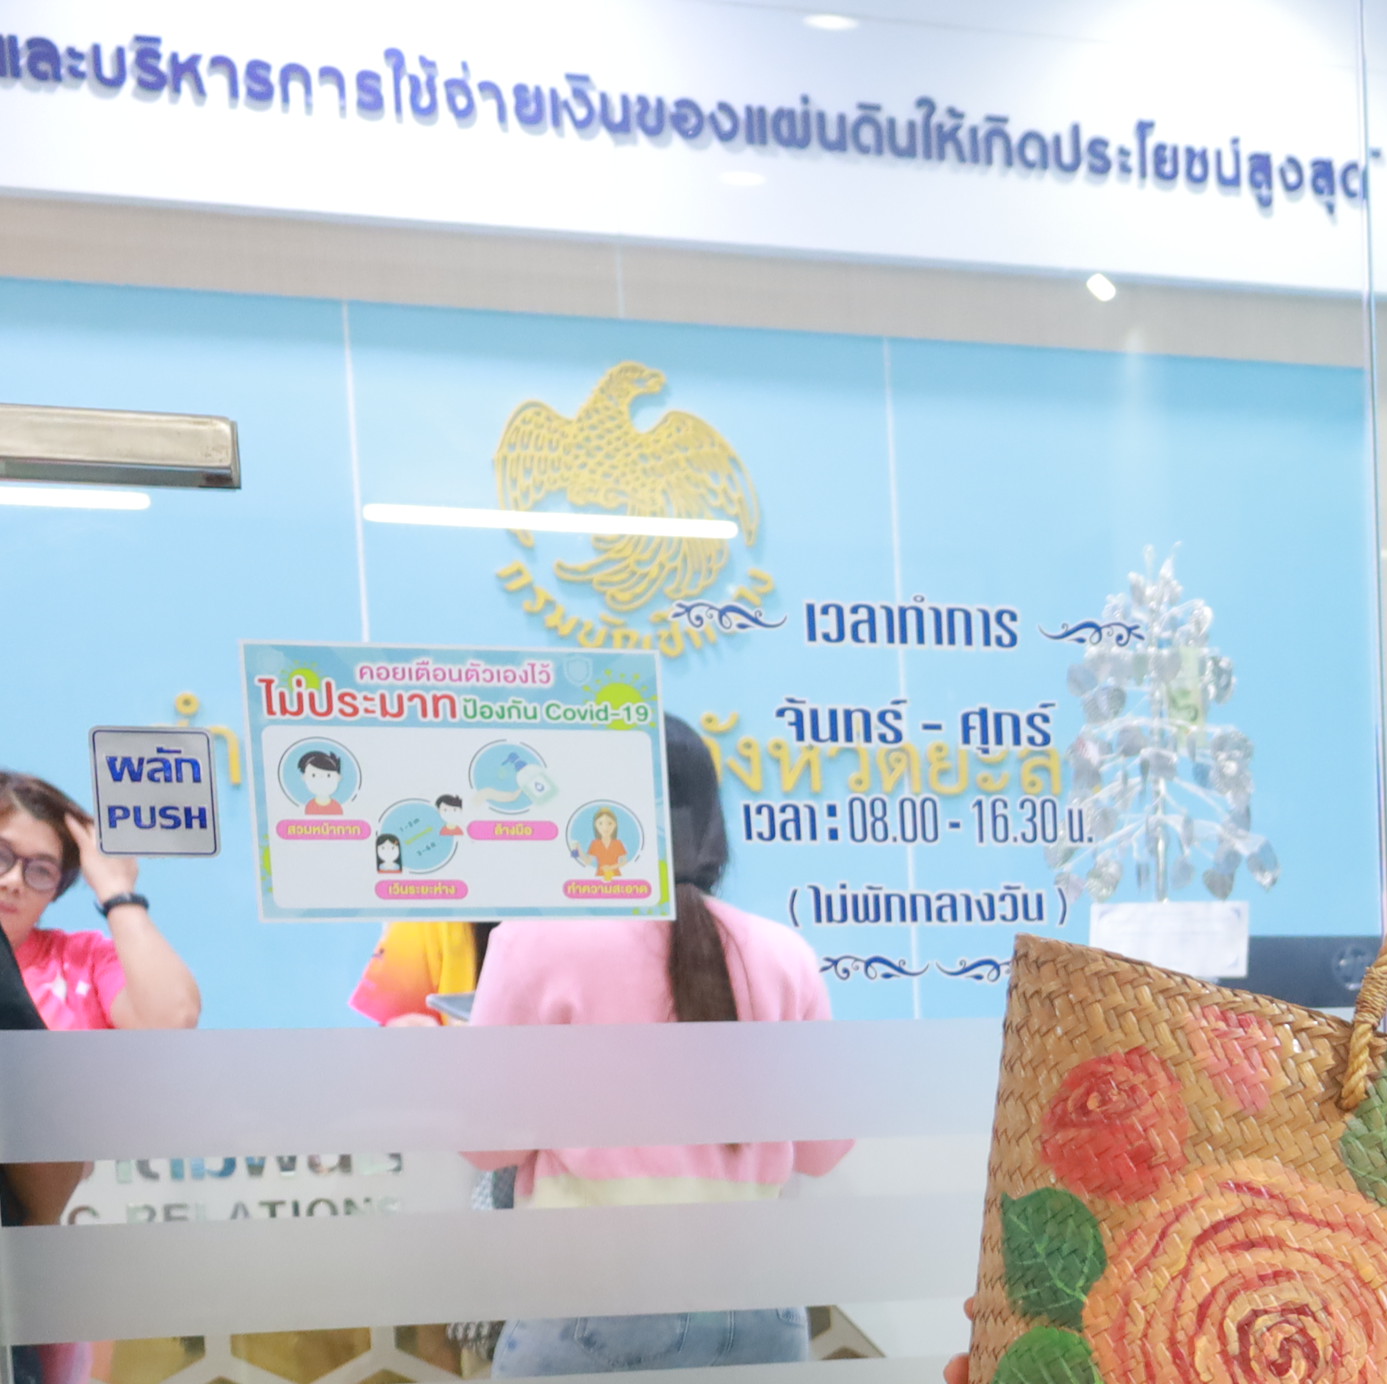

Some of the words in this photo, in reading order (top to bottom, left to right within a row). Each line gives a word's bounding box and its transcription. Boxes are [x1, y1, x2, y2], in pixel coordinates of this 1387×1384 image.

[805, 596, 1019, 649] เวลาทำการ
[357, 659, 553, 686] คอยเตือนตัวเองไว้
[258, 677, 457, 721] ไม่ประมาท
[463, 698, 538, 722] ป้องกัน
[545, 702, 649, 723] Covid-19
[775, 698, 907, 744] จันทร์
[961, 703, 1056, 754] ศุกร์
[106, 746, 202, 783] ผลัก
[108, 805, 207, 830] PUSH
[287, 821, 361, 836] สวมหน้ากาก
[494, 822, 532, 837] ล้างมือ
[848, 797, 939, 843] 08.00
[972, 798, 1058, 844] 16.30
[566, 882, 649, 896] ทำความสะอาด
